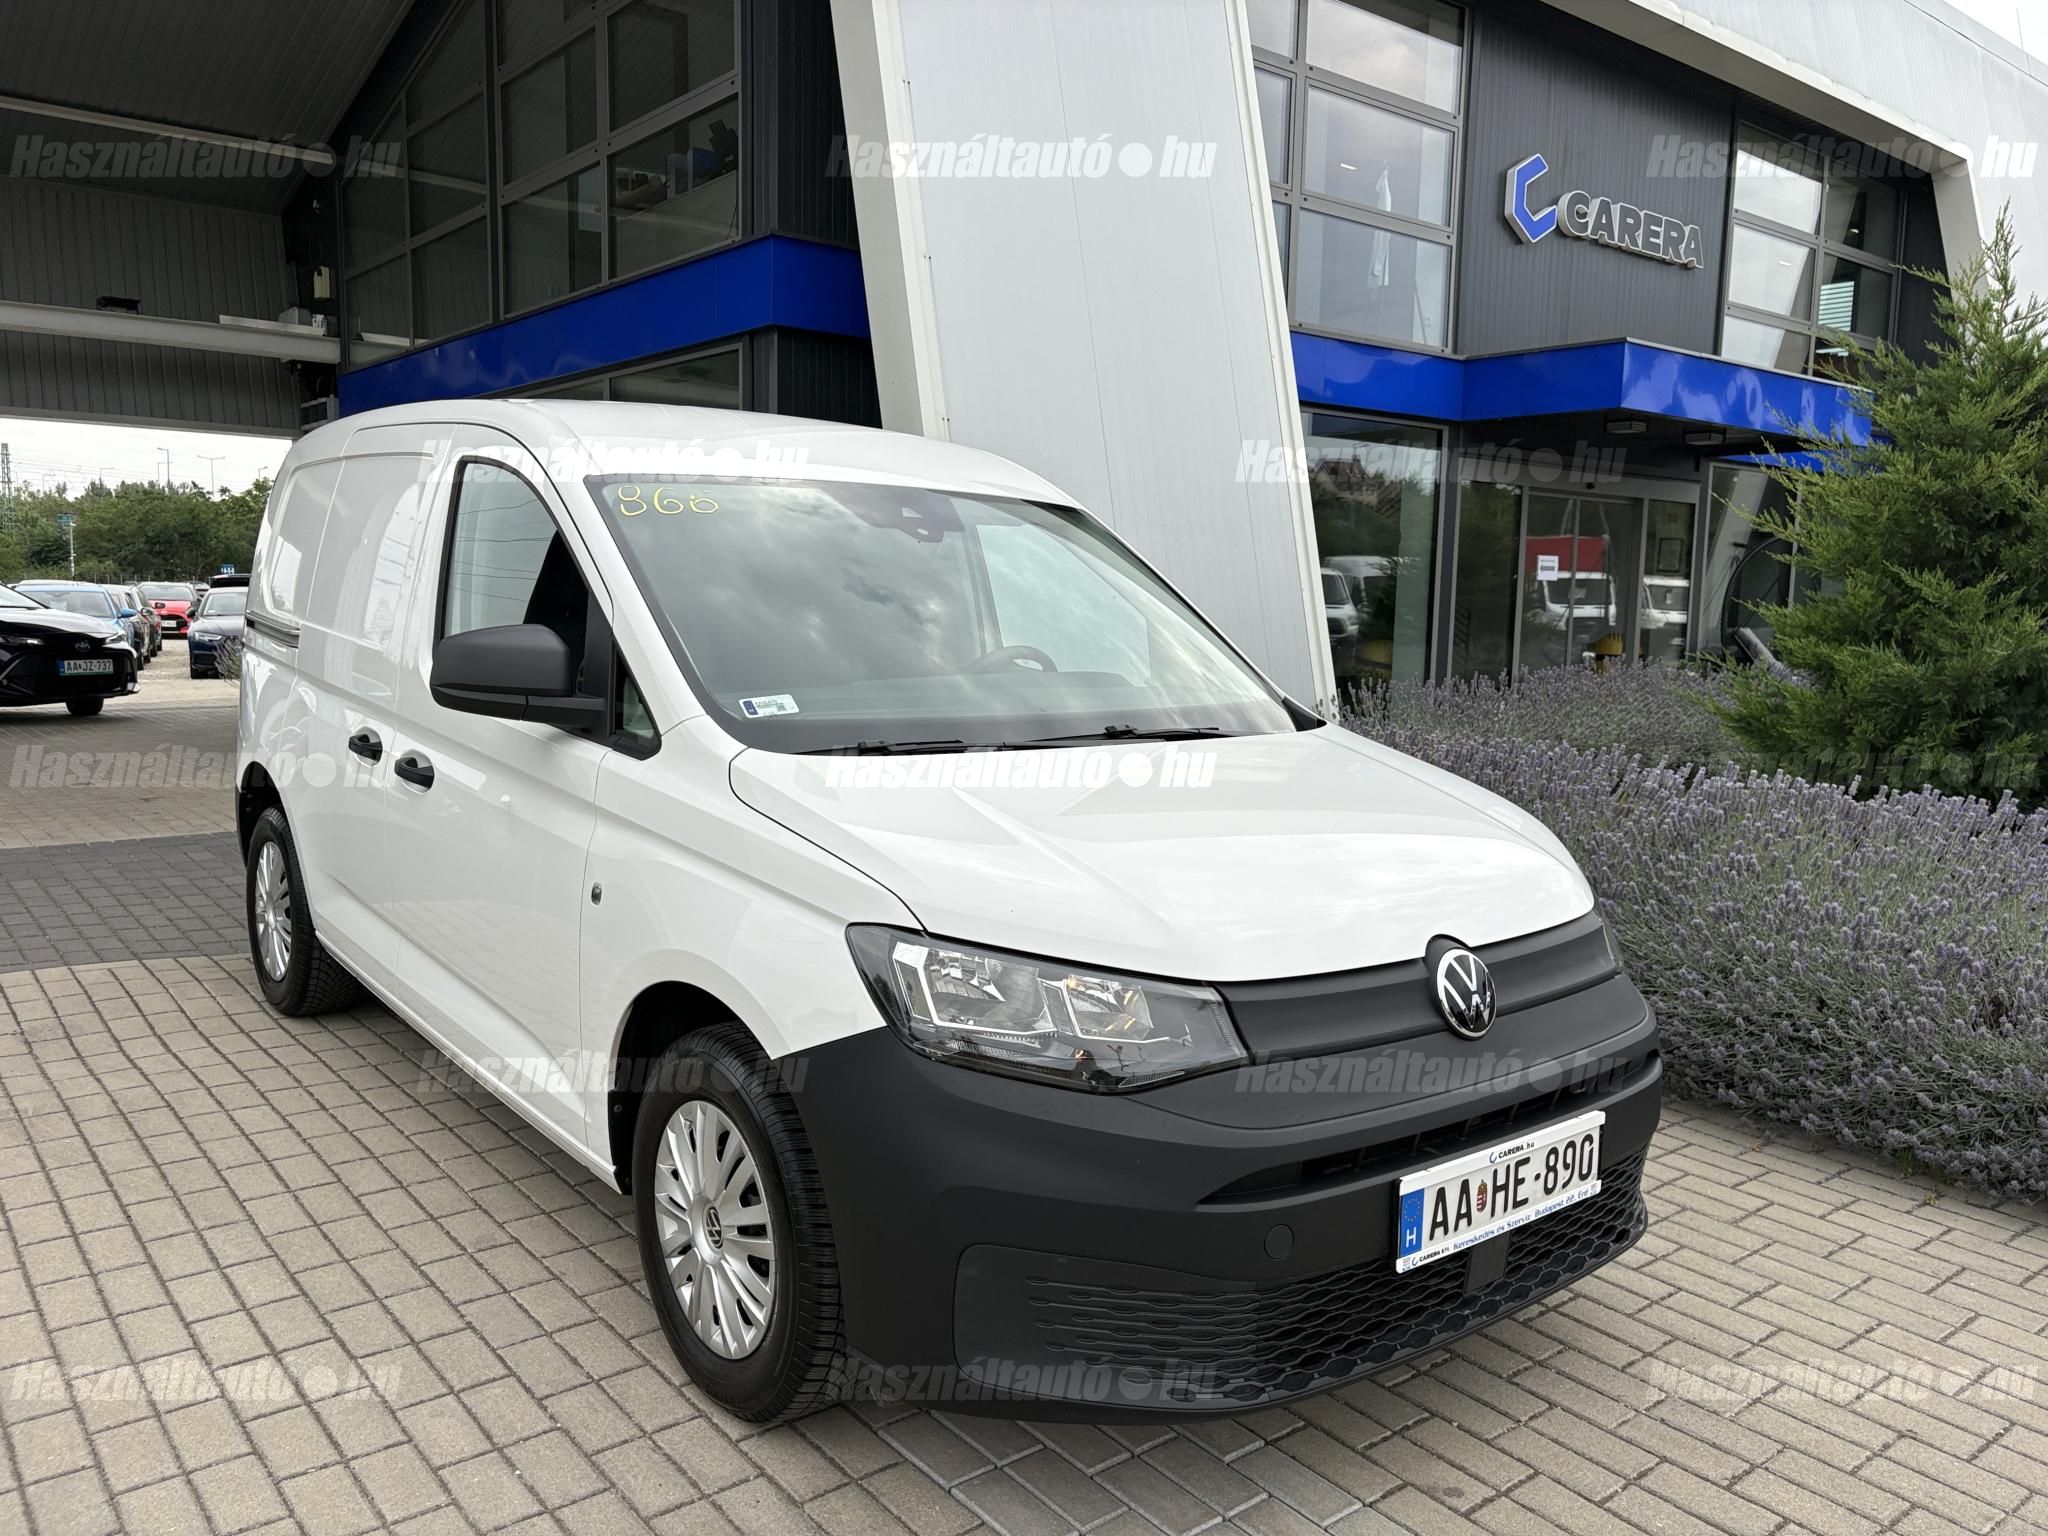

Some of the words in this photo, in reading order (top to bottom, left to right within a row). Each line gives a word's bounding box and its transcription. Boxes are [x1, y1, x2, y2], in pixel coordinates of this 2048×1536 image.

[1556, 189, 1704, 270] CARERA
[1405, 1226, 1417, 1248] H
[1428, 1178, 1473, 1241] AA
